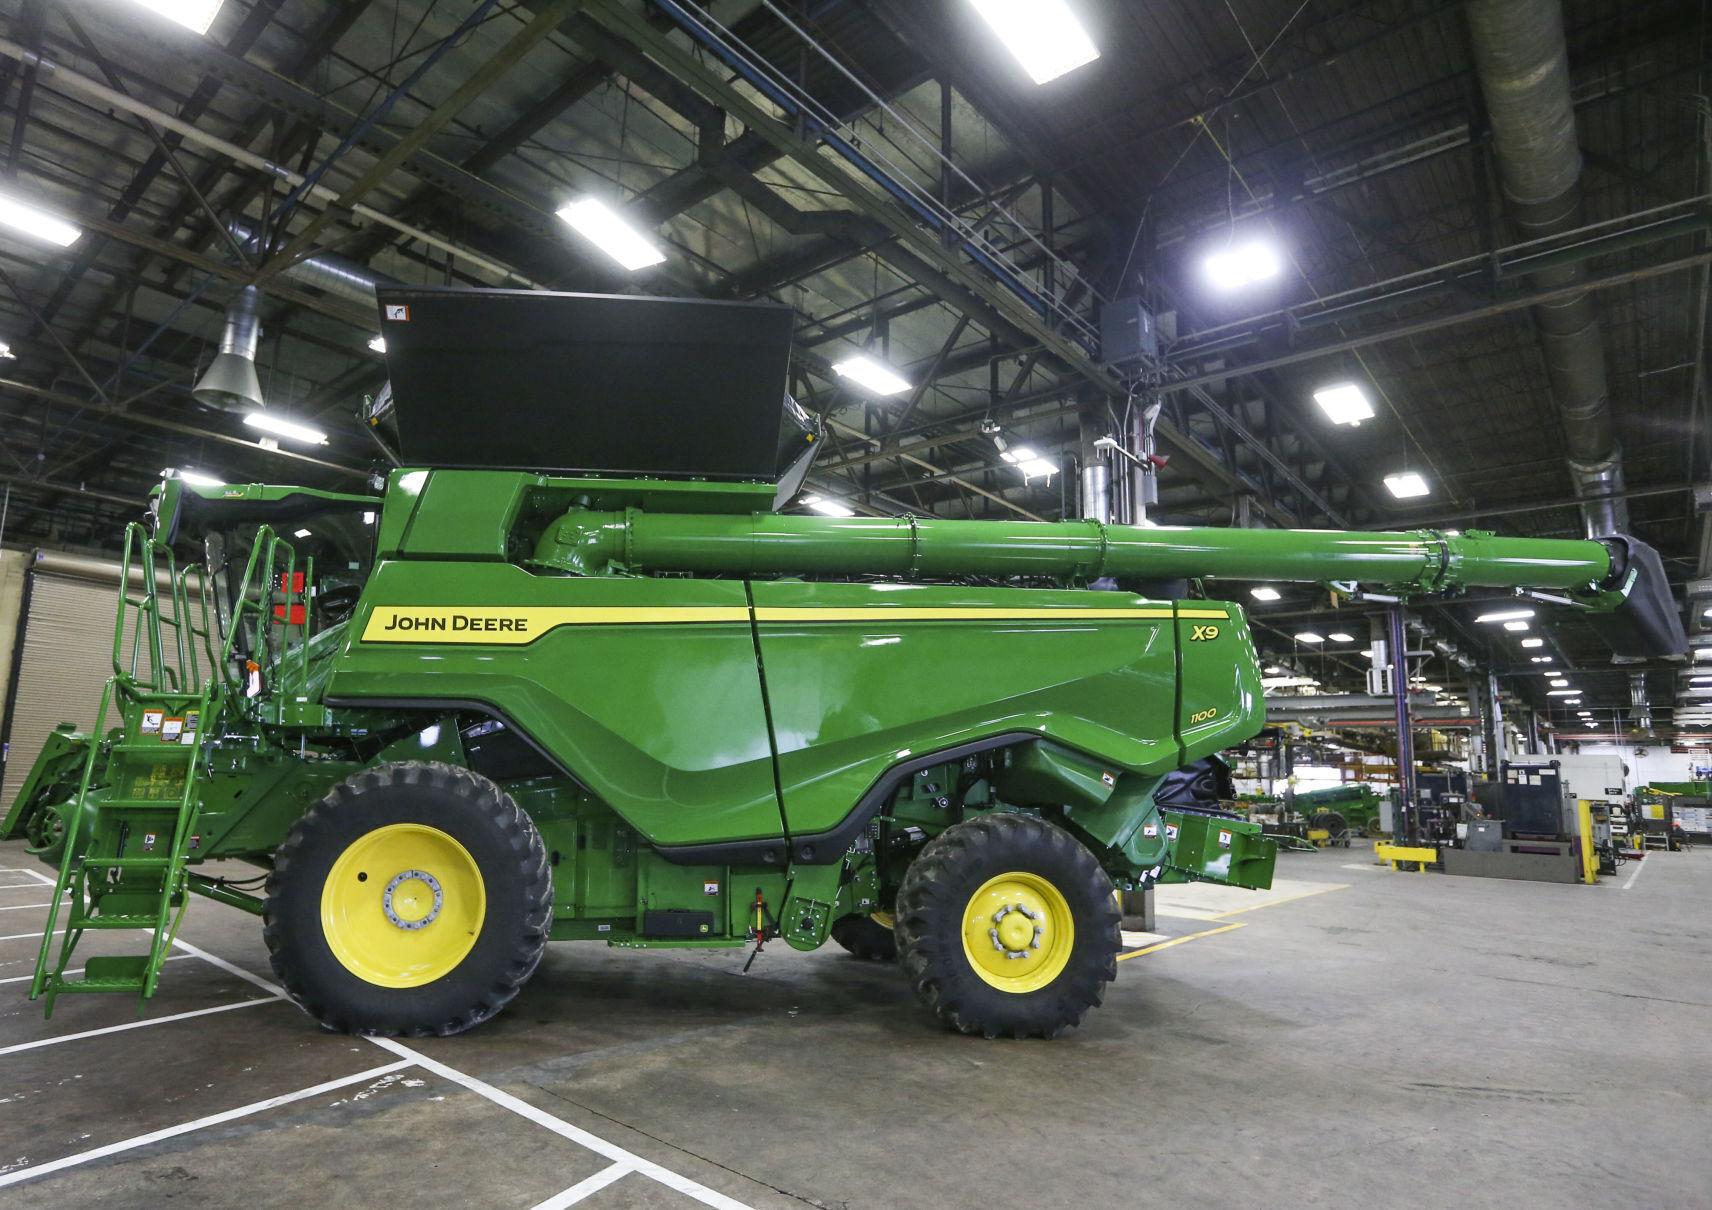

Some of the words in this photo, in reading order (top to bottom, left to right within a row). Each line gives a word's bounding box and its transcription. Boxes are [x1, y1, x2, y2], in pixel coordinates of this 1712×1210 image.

[384, 614, 446, 631] JOHN
[452, 615, 528, 632] DEERE
[1190, 625, 1220, 641] X9
[1190, 707, 1217, 724] 1100
